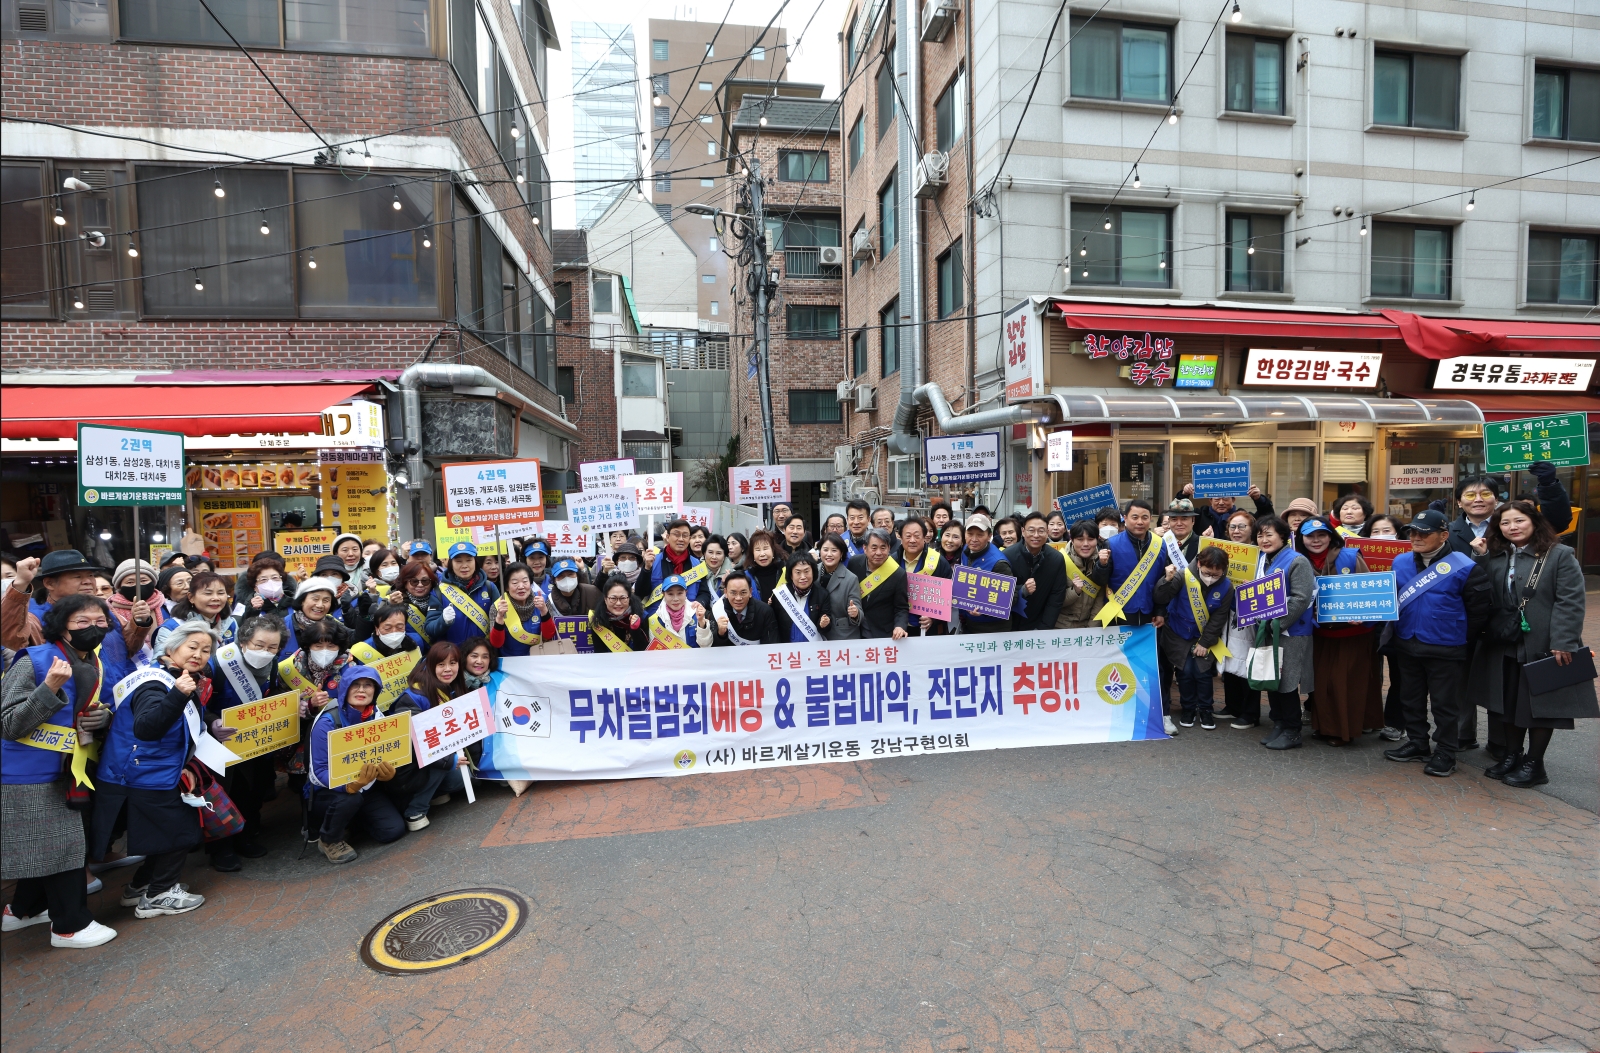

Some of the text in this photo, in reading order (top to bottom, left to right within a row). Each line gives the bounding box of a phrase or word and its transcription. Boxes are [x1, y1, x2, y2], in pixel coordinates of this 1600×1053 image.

[1084, 332, 1174, 360] 한양김밥
[1131, 362, 1171, 386] 국수
[1180, 364, 1214, 376] 한양김밥
[1451, 363, 1578, 384] 경북유통 고추가루 전문
[1499, 419, 1570, 433] 제로웨이스트
[1522, 430, 1549, 440] 실천
[121, 438, 153, 452] 2권역
[951, 441, 973, 450] 1권역
[86, 455, 180, 469] 삼성1동, 삼성2동, 대치1동
[321, 452, 384, 461] 영동황제마실거리
[1523, 451, 1552, 460] 확립
[105, 471, 167, 482] 대치2동, 대치4동
[478, 469, 506, 480] 4권역
[1390, 477, 1410, 485] 고추장
[450, 483, 536, 496] 개포3동, 개포4동, 일원본동
[738, 478, 781, 494] 불조심
[100, 492, 182, 501] 바르게살기운동강남구협의회
[456, 494, 532, 507] 일원1동, 수서동, 세곡동
[204, 501, 259, 509] 영동황제꽈배기
[572, 507, 586, 515] 불법
[590, 504, 611, 513] 광고물
[464, 511, 540, 522] 바르게살기운동강남구협의회
[546, 533, 586, 547] 불조심
[283, 544, 331, 555] 감사이벤트
[1228, 563, 1248, 572] 리문화
[958, 571, 1010, 592] 불법 마약류
[1114, 551, 1155, 605] 깨끗한 거리문화 YES
[1240, 578, 1281, 601] 불법 마약류
[1320, 579, 1391, 591] 올바른 건설 문화정착
[445, 586, 466, 605] 깨끗한
[967, 587, 998, 603] 근절
[1250, 594, 1274, 611] 근절
[1321, 601, 1345, 610] 아름다운
[1347, 600, 1377, 609] 거리문화의
[558, 621, 576, 633] 불법
[1002, 638, 1046, 651] 함께하는
[386, 669, 399, 678] NO
[236, 698, 288, 720] 불법전단지
[568, 662, 1080, 744] 무차별범죄예방 & 불법마약, 전단지 추방!!
[256, 714, 271, 724] NO
[235, 719, 290, 743] 깨끗한 거리문화
[343, 719, 398, 742] 불법전단지
[423, 708, 480, 749] 불조심
[61, 732, 76, 751] YES
[254, 735, 273, 747] YES
[364, 734, 381, 745] NO
[342, 740, 401, 765] 깨끗한 거리문화
[705, 732, 970, 766] (사) 바르게살기운동 강남구협의회
